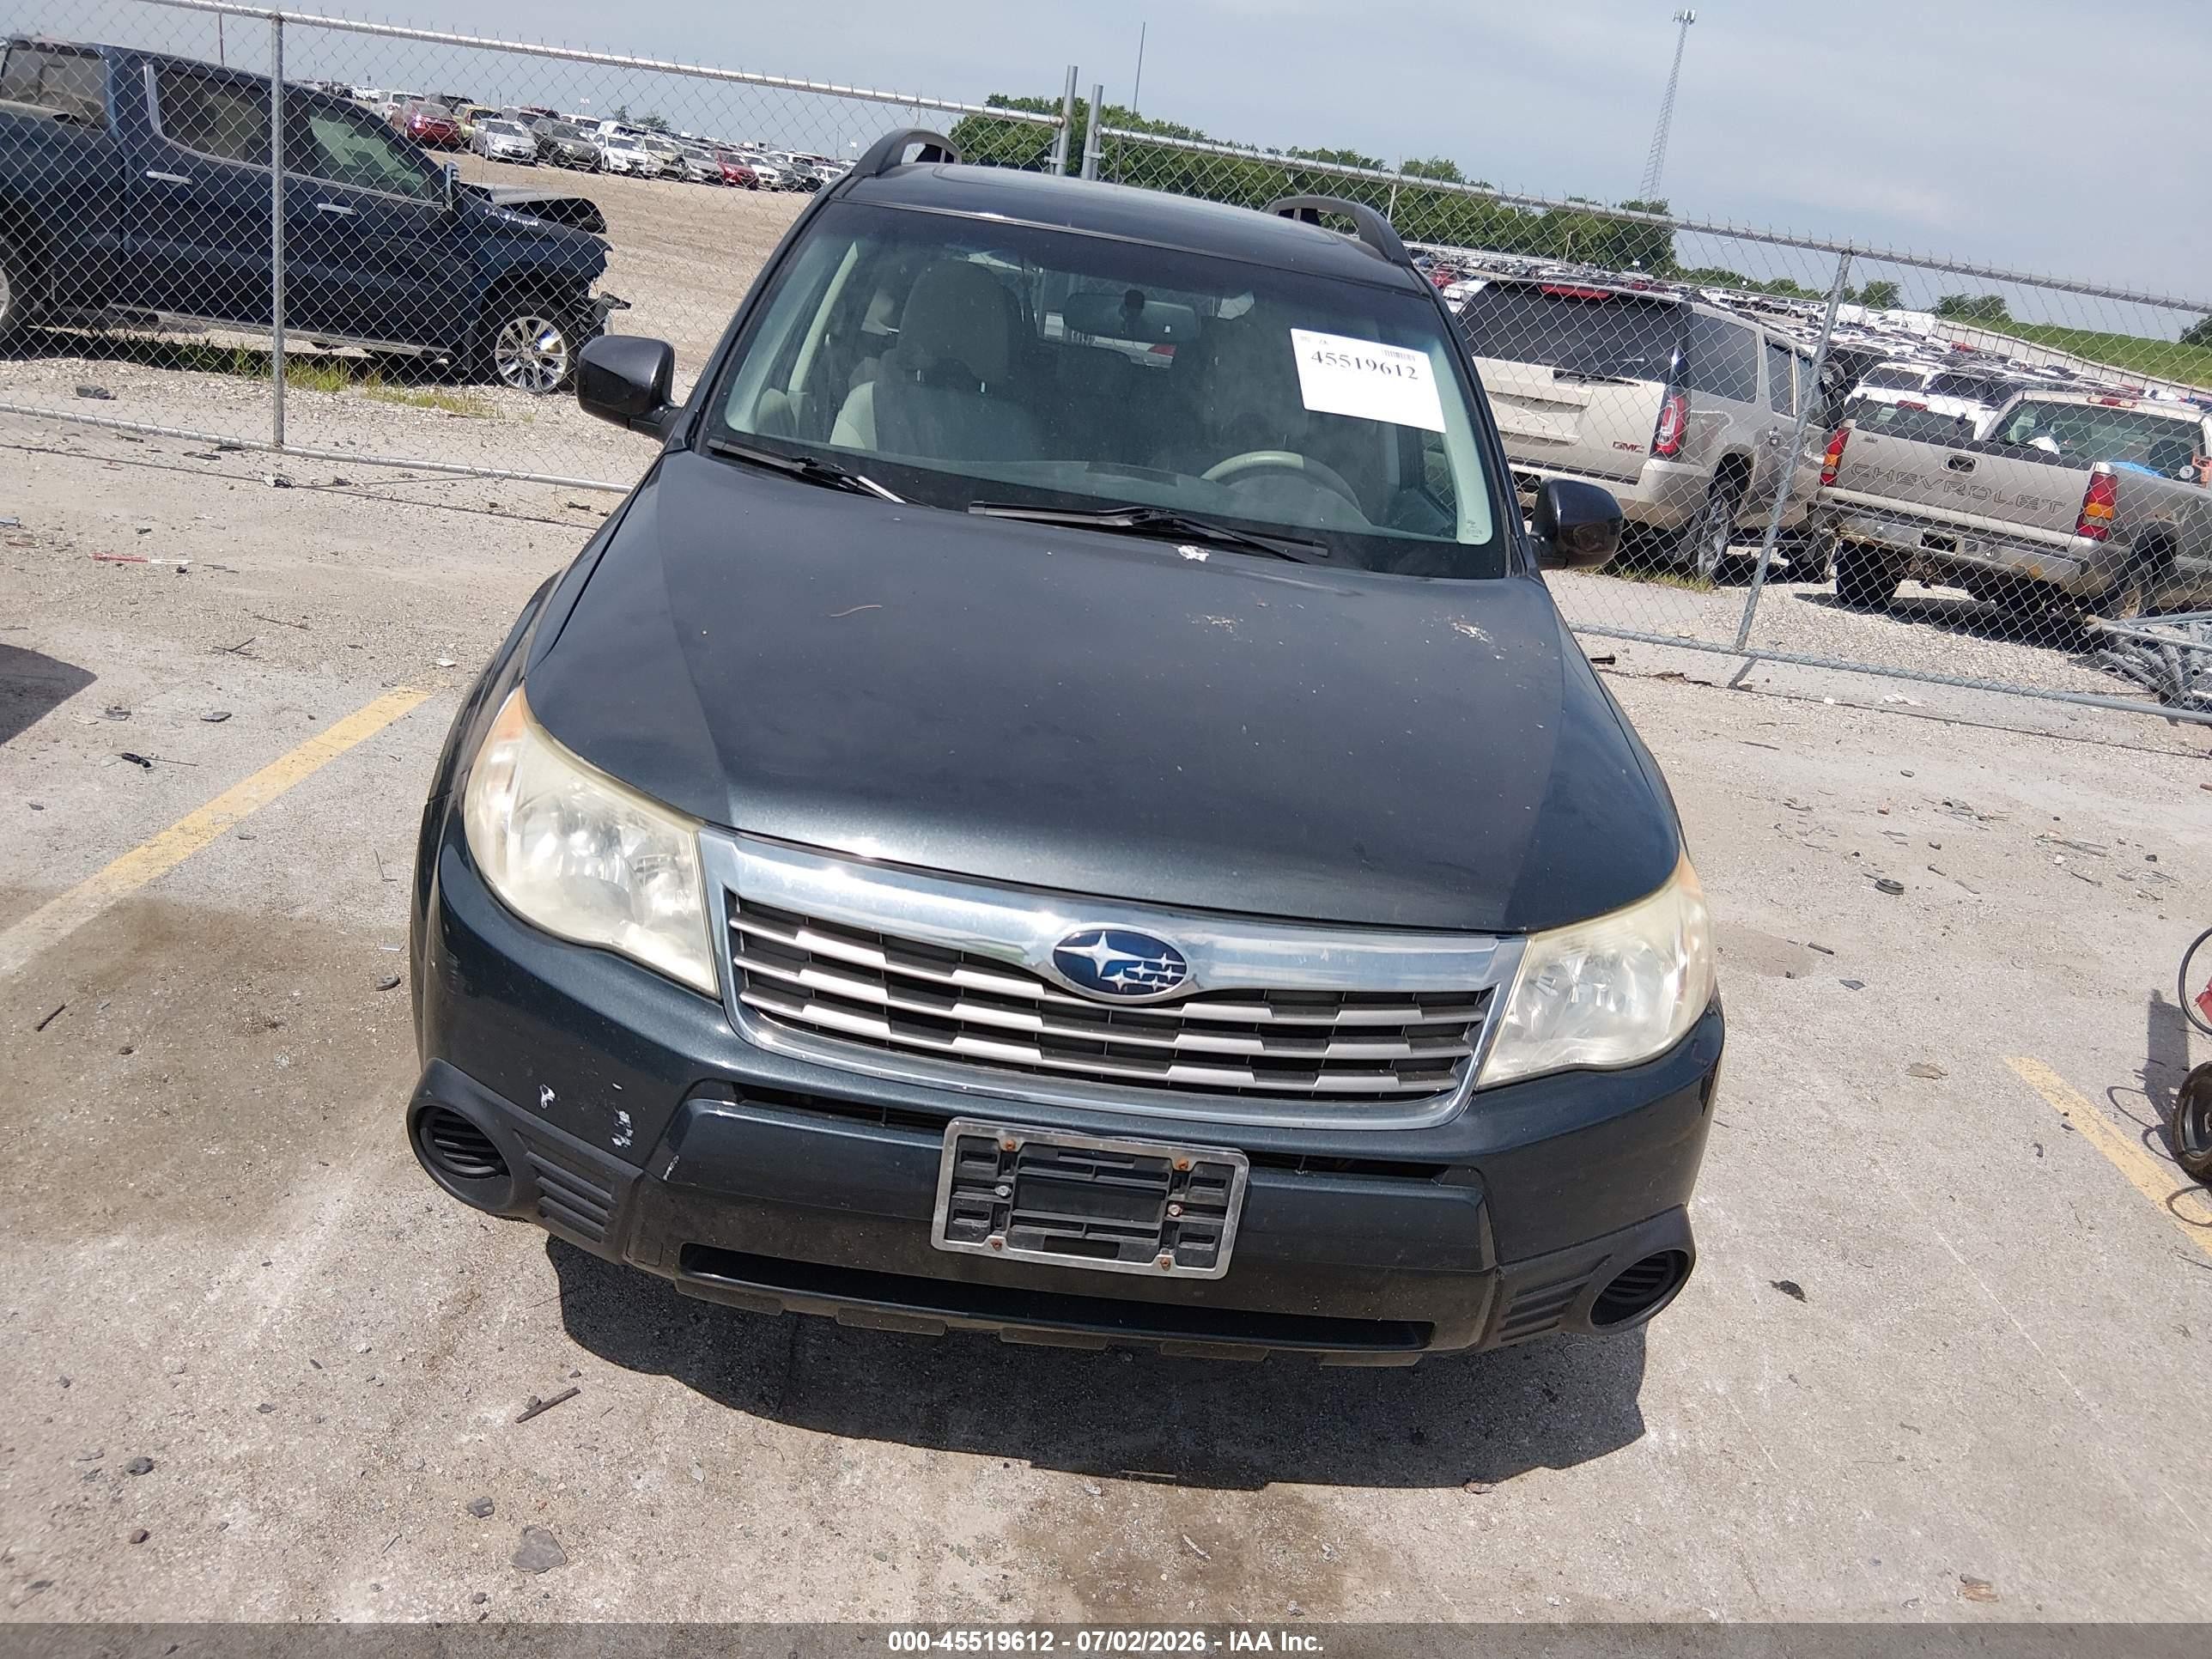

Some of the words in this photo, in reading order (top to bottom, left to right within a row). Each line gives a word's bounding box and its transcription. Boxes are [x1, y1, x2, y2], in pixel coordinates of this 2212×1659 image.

[1310, 350, 1419, 380] 45519612
[1612, 441, 1645, 454] GMC
[1850, 463, 2067, 514] CHEVROLET
